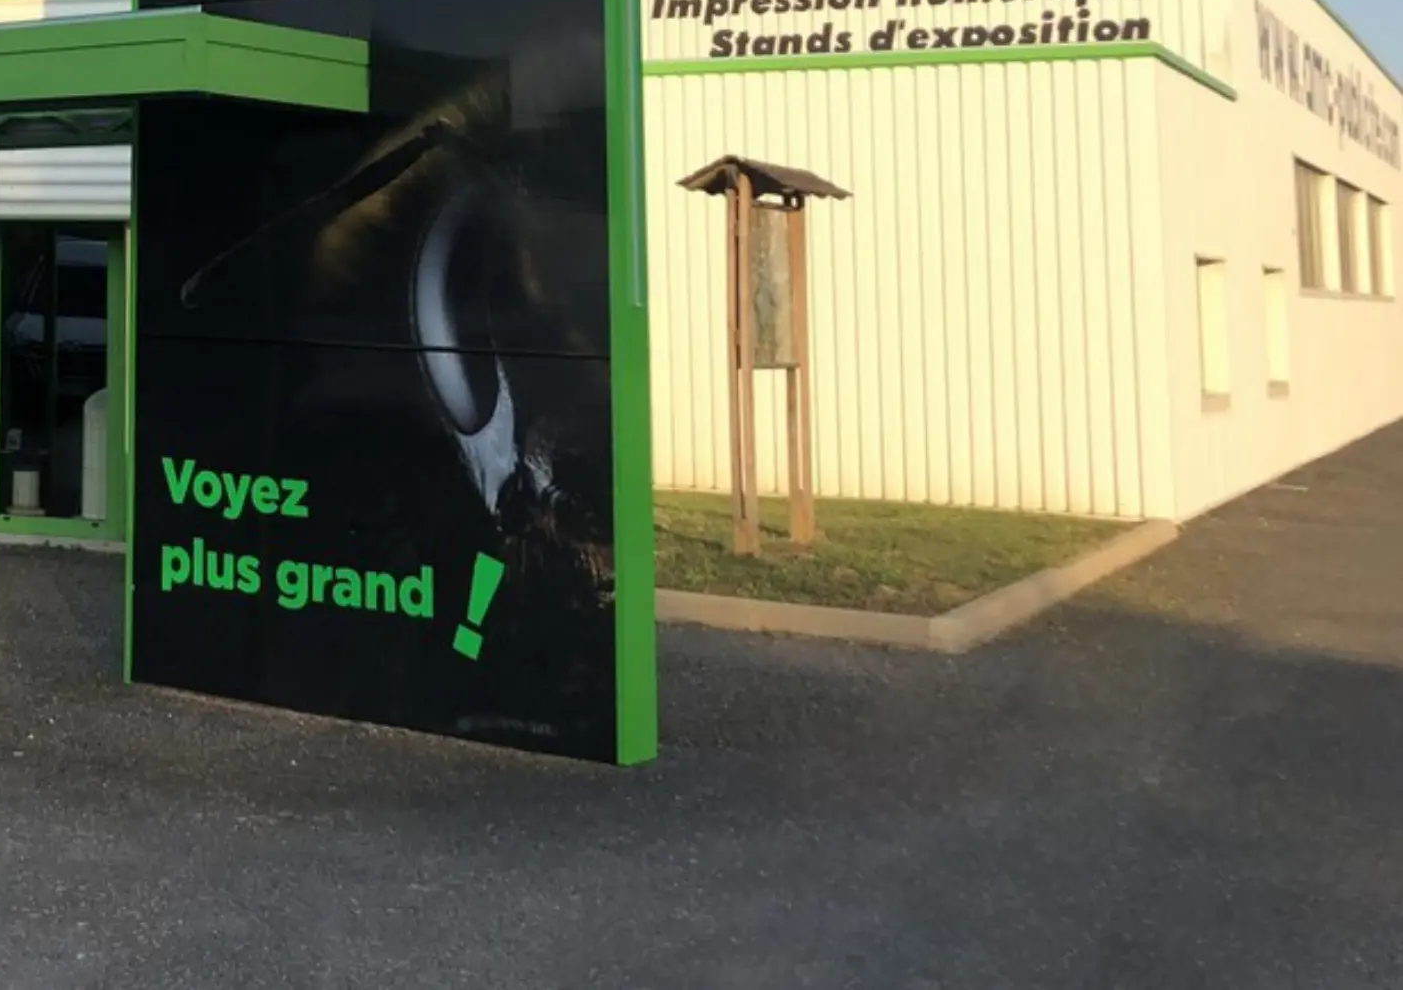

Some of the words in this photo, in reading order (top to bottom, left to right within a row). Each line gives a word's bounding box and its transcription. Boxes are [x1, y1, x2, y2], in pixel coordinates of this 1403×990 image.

[709, 22, 853, 58] Stands
[869, 8, 1151, 51] d'exposition
[162, 457, 309, 519] Voyez
[161, 537, 261, 593] plus
[276, 560, 435, 618] grand
